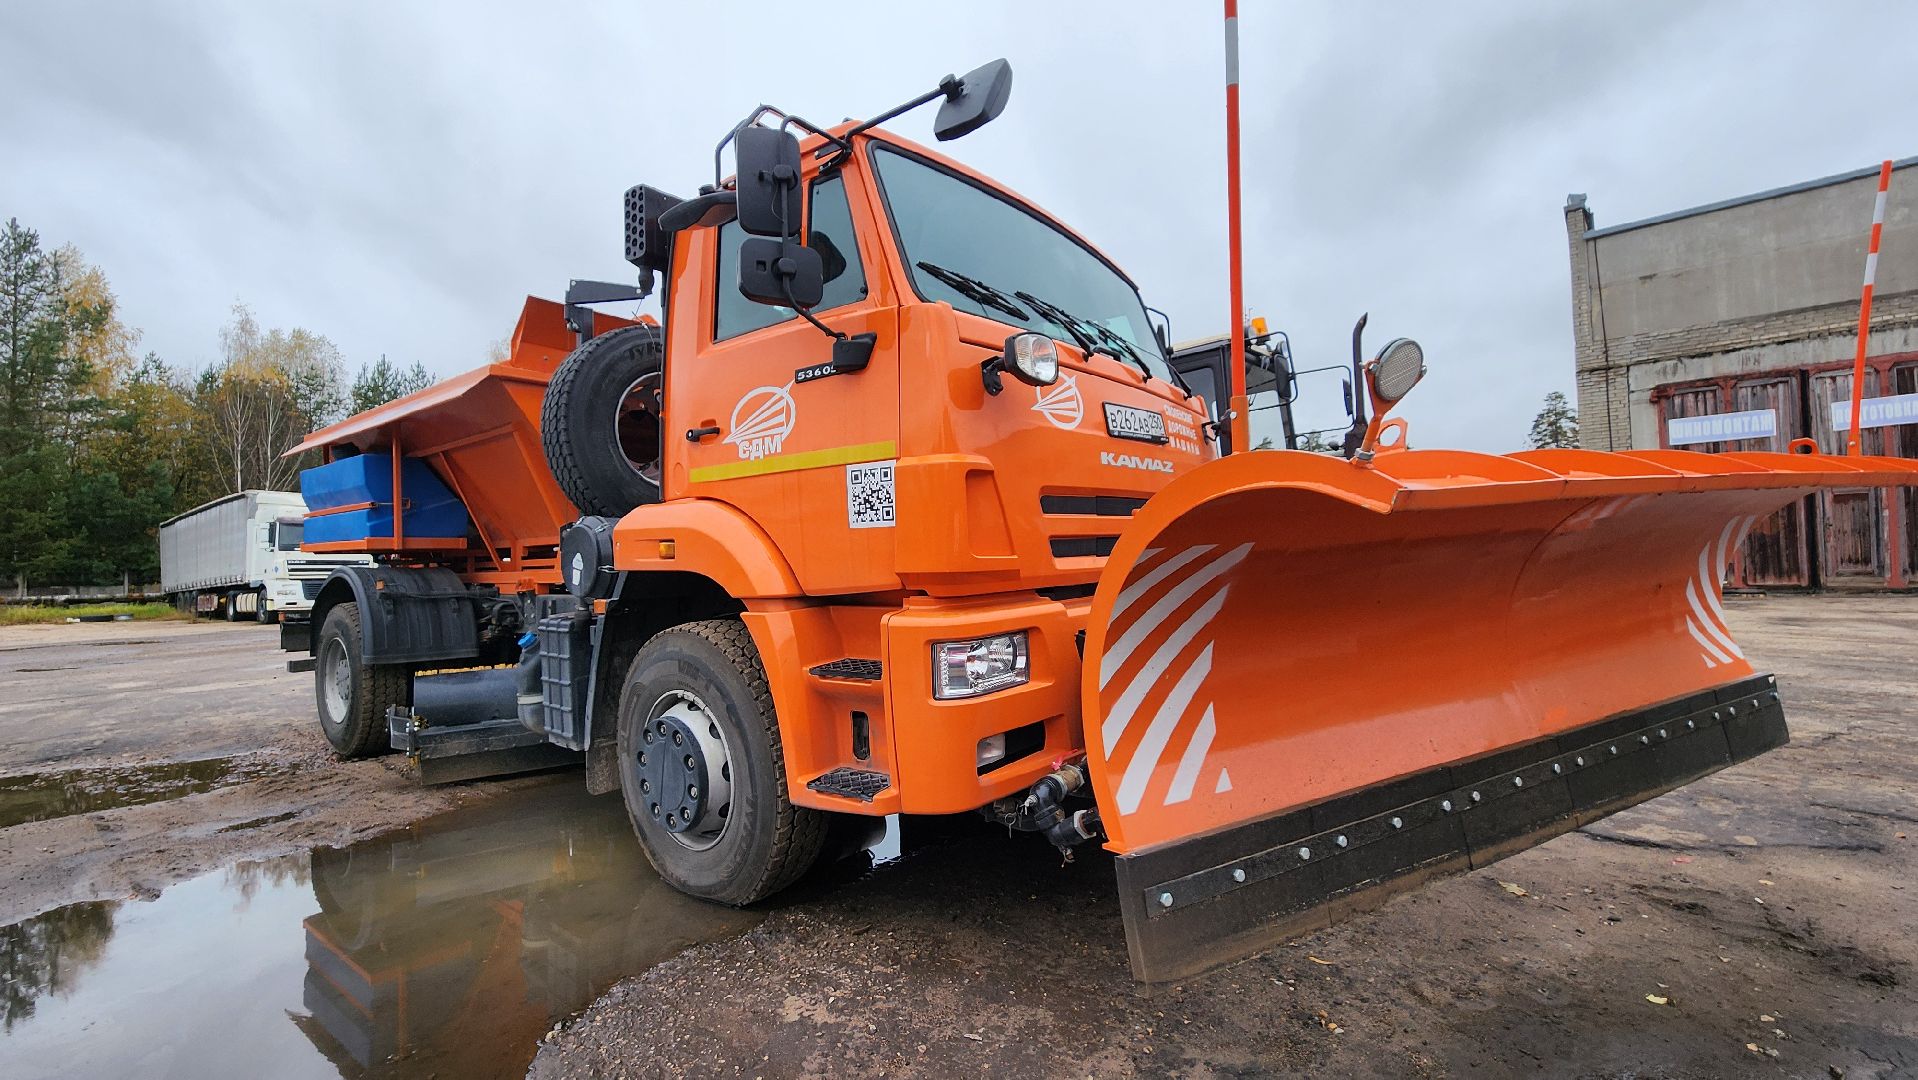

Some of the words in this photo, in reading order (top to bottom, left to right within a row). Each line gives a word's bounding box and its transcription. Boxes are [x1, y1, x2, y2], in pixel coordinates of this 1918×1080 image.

[1670, 414, 1773, 439] ШИНОМОНТАЖ
[738, 434, 782, 461] СДМ
[1100, 451, 1174, 473] KAMAZ
